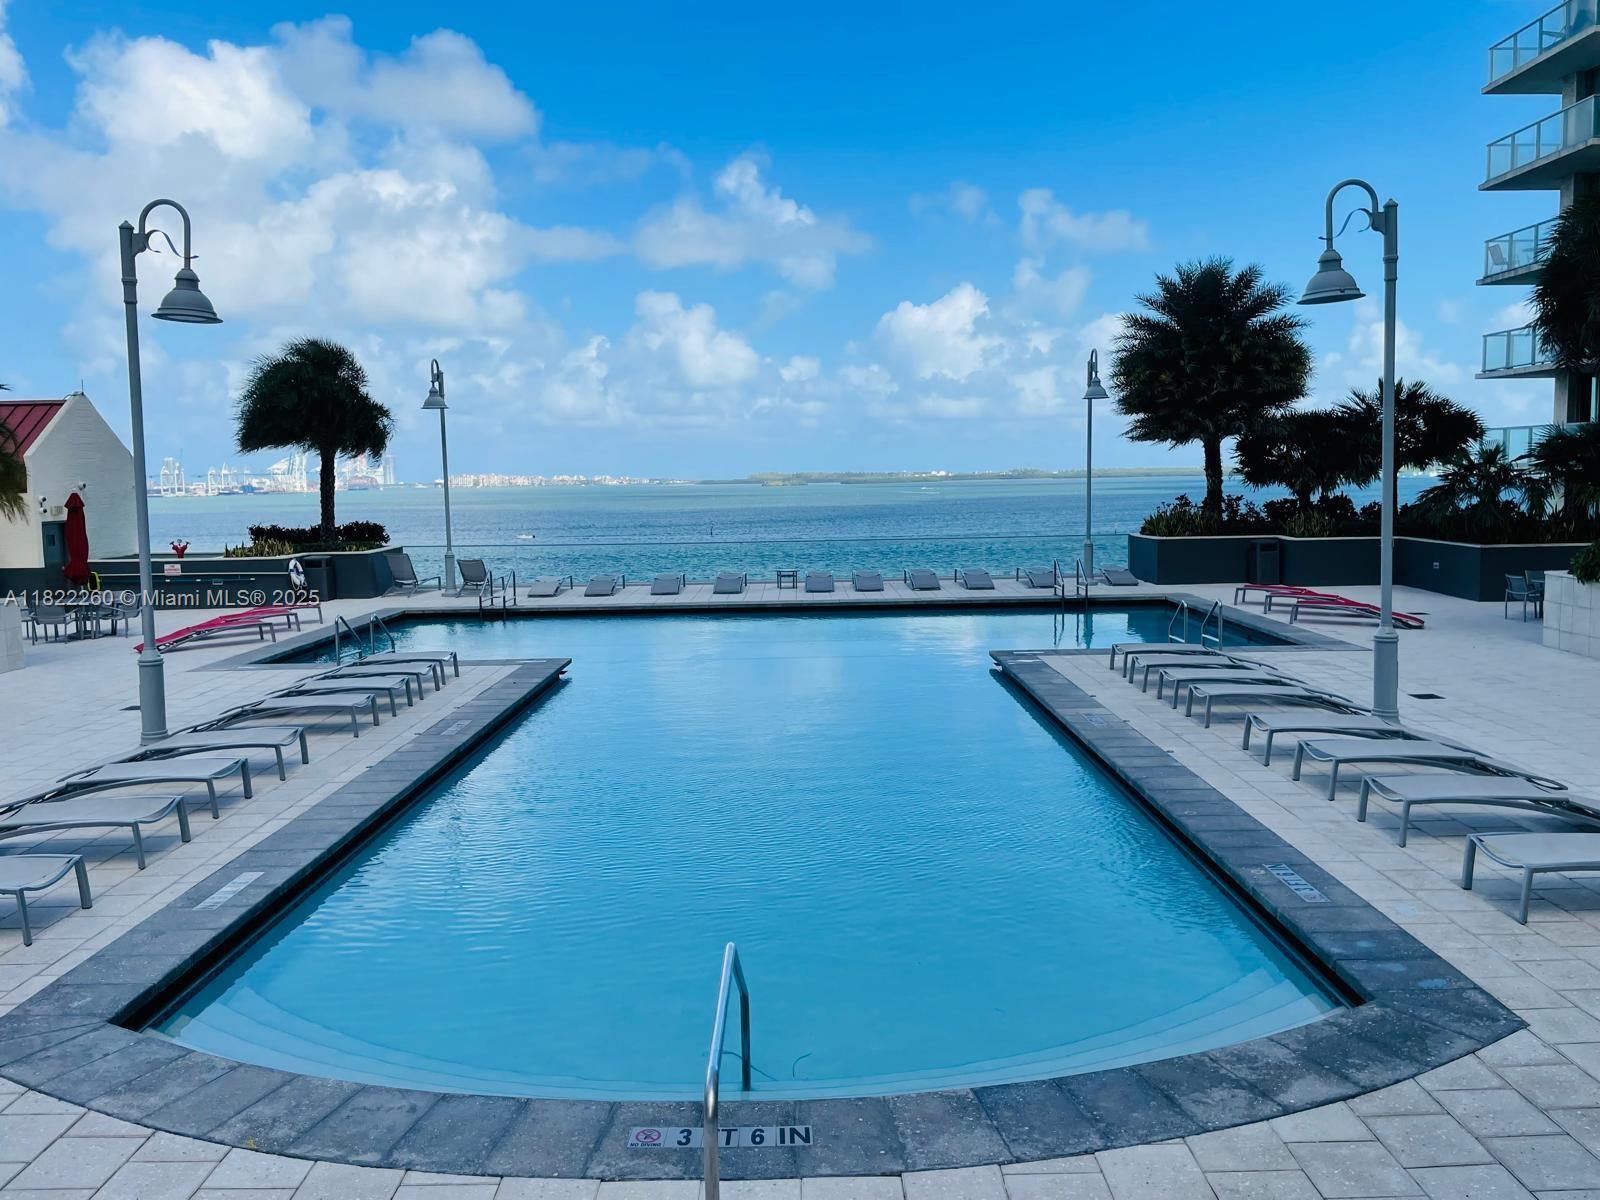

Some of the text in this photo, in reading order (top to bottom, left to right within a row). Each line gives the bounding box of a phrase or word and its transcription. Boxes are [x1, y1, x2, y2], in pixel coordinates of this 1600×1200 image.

[676, 1127, 811, 1146] 3 T 6 IN
